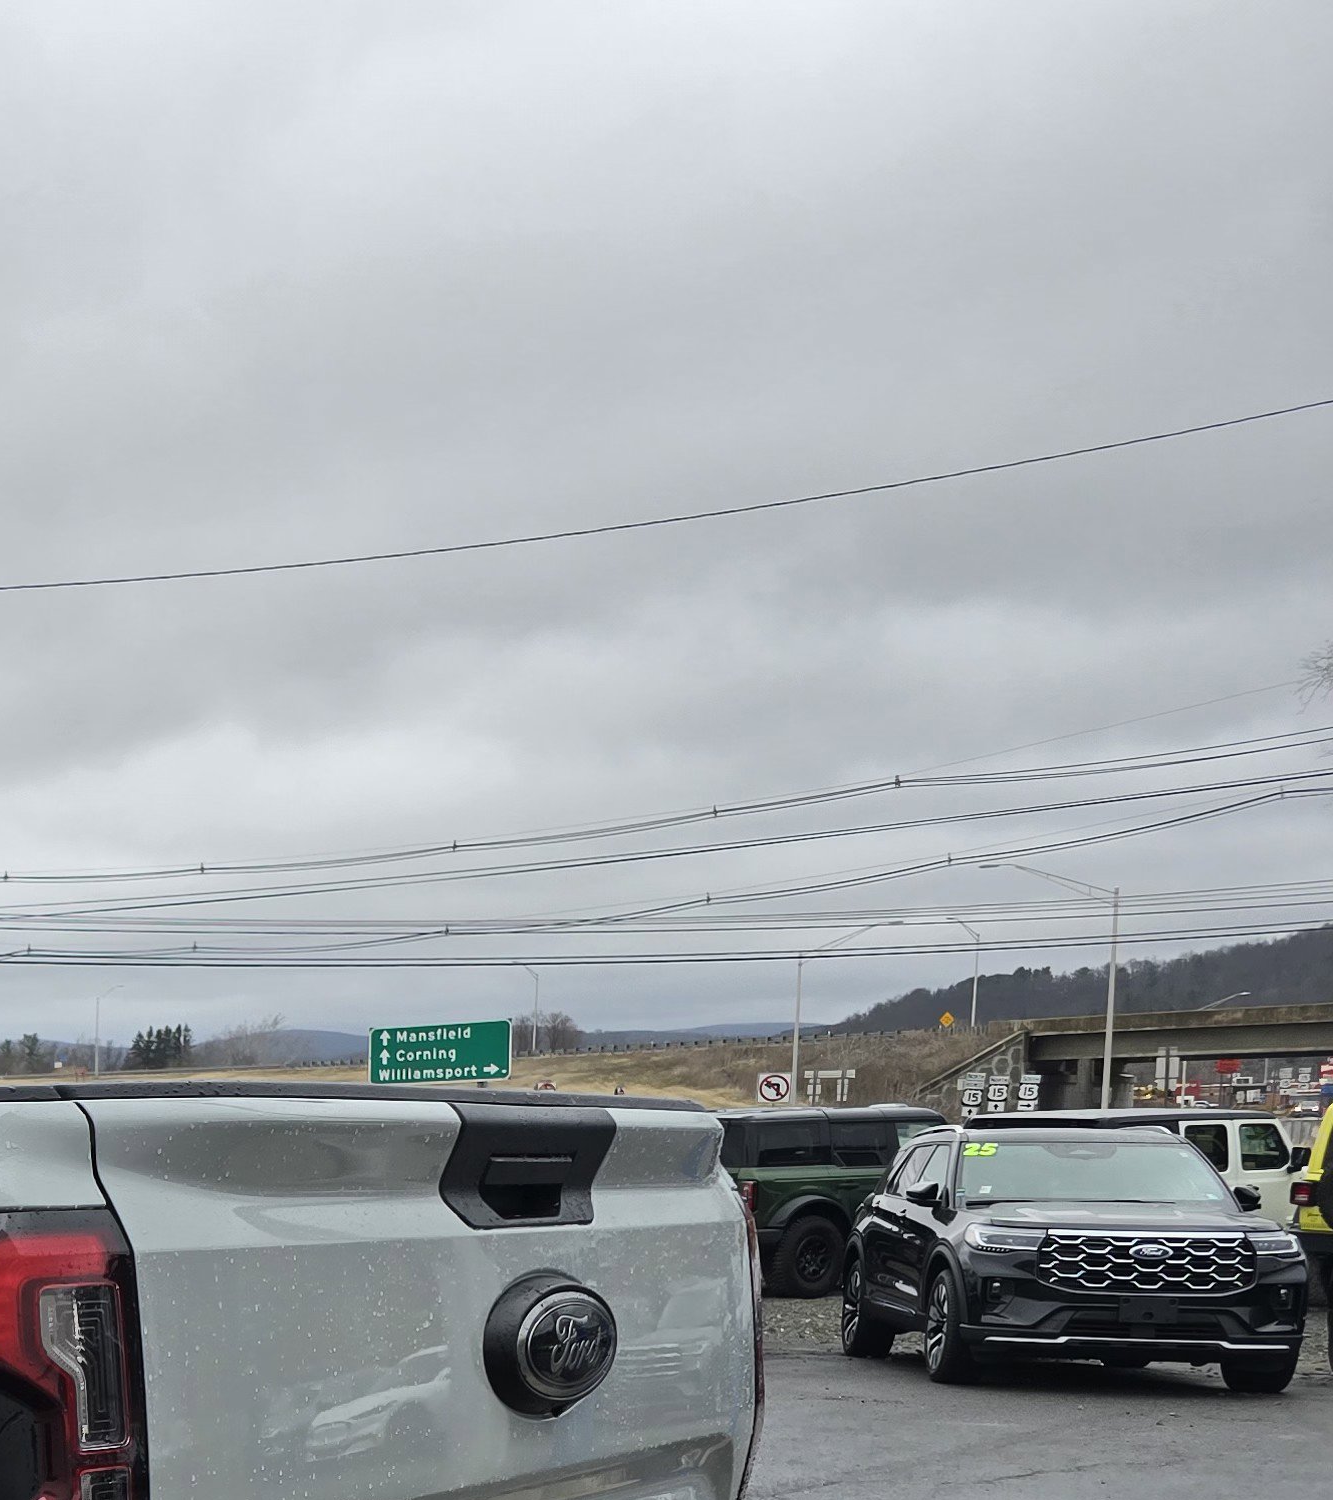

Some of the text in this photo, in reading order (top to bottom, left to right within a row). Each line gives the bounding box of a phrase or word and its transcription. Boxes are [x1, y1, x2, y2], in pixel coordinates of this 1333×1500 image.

[396, 1027, 471, 1043] Mansfield
[396, 1047, 456, 1063] Corning
[379, 1065, 477, 1082] Williamsport
[968, 1092, 979, 1102] 15
[993, 1088, 1004, 1098] 15
[1023, 1086, 1035, 1097] 15
[963, 1142, 999, 1156] 25
[550, 1313, 604, 1377] Ford
